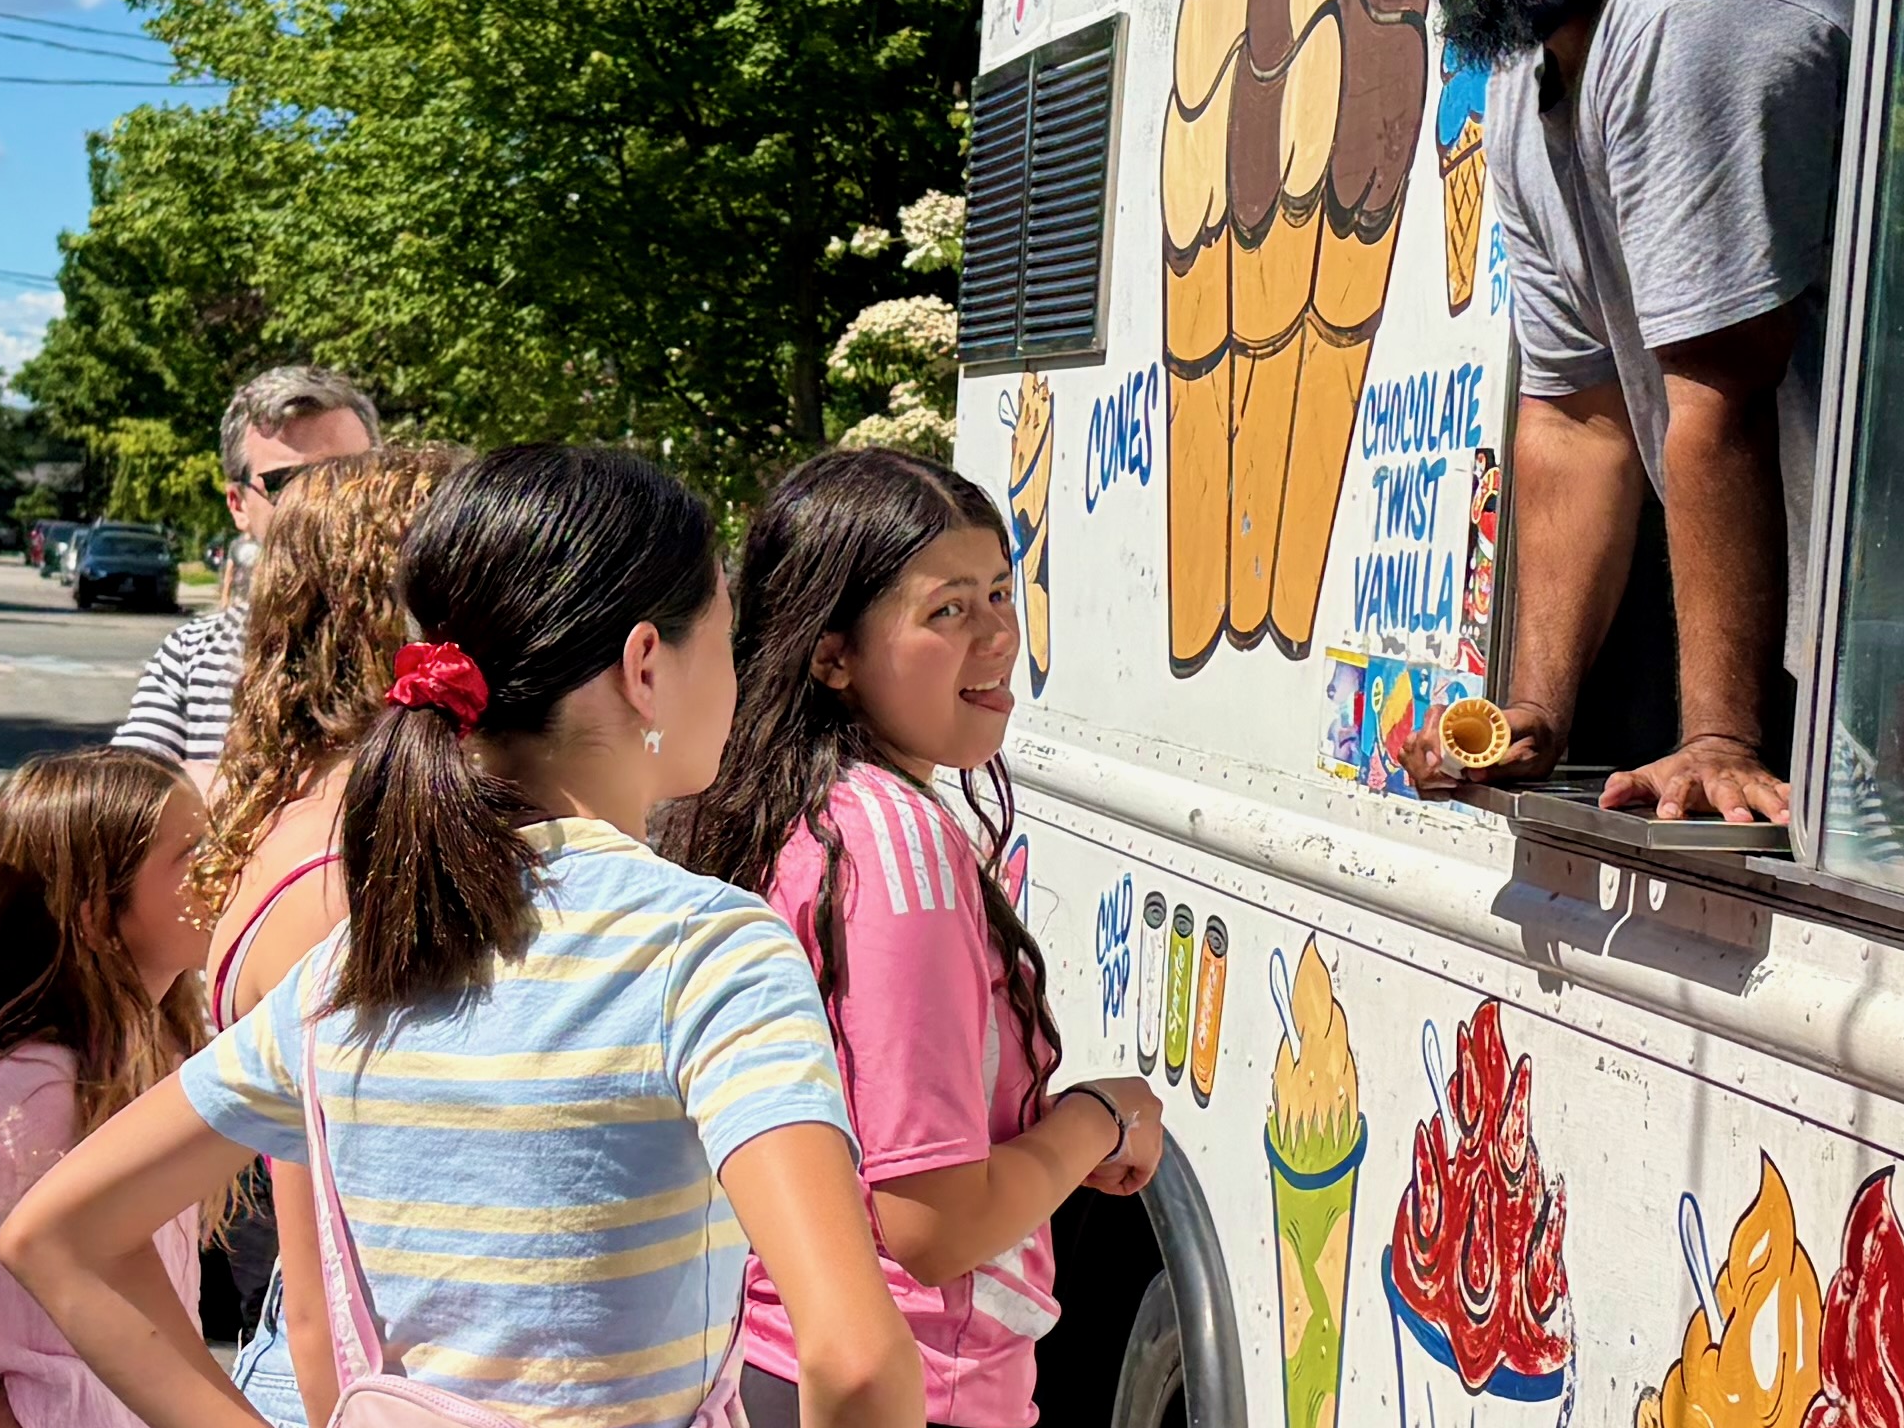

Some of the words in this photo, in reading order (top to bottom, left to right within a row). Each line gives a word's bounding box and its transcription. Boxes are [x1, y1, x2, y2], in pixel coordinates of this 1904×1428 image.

[1086, 362, 1159, 515] CONES
[1362, 362, 1485, 461] CHOCOLATE
[1372, 456, 1448, 544] TWIST
[1354, 548, 1454, 635] VANILLA
[1096, 872, 1133, 965] COLD
[1102, 943, 1131, 1038] POP
